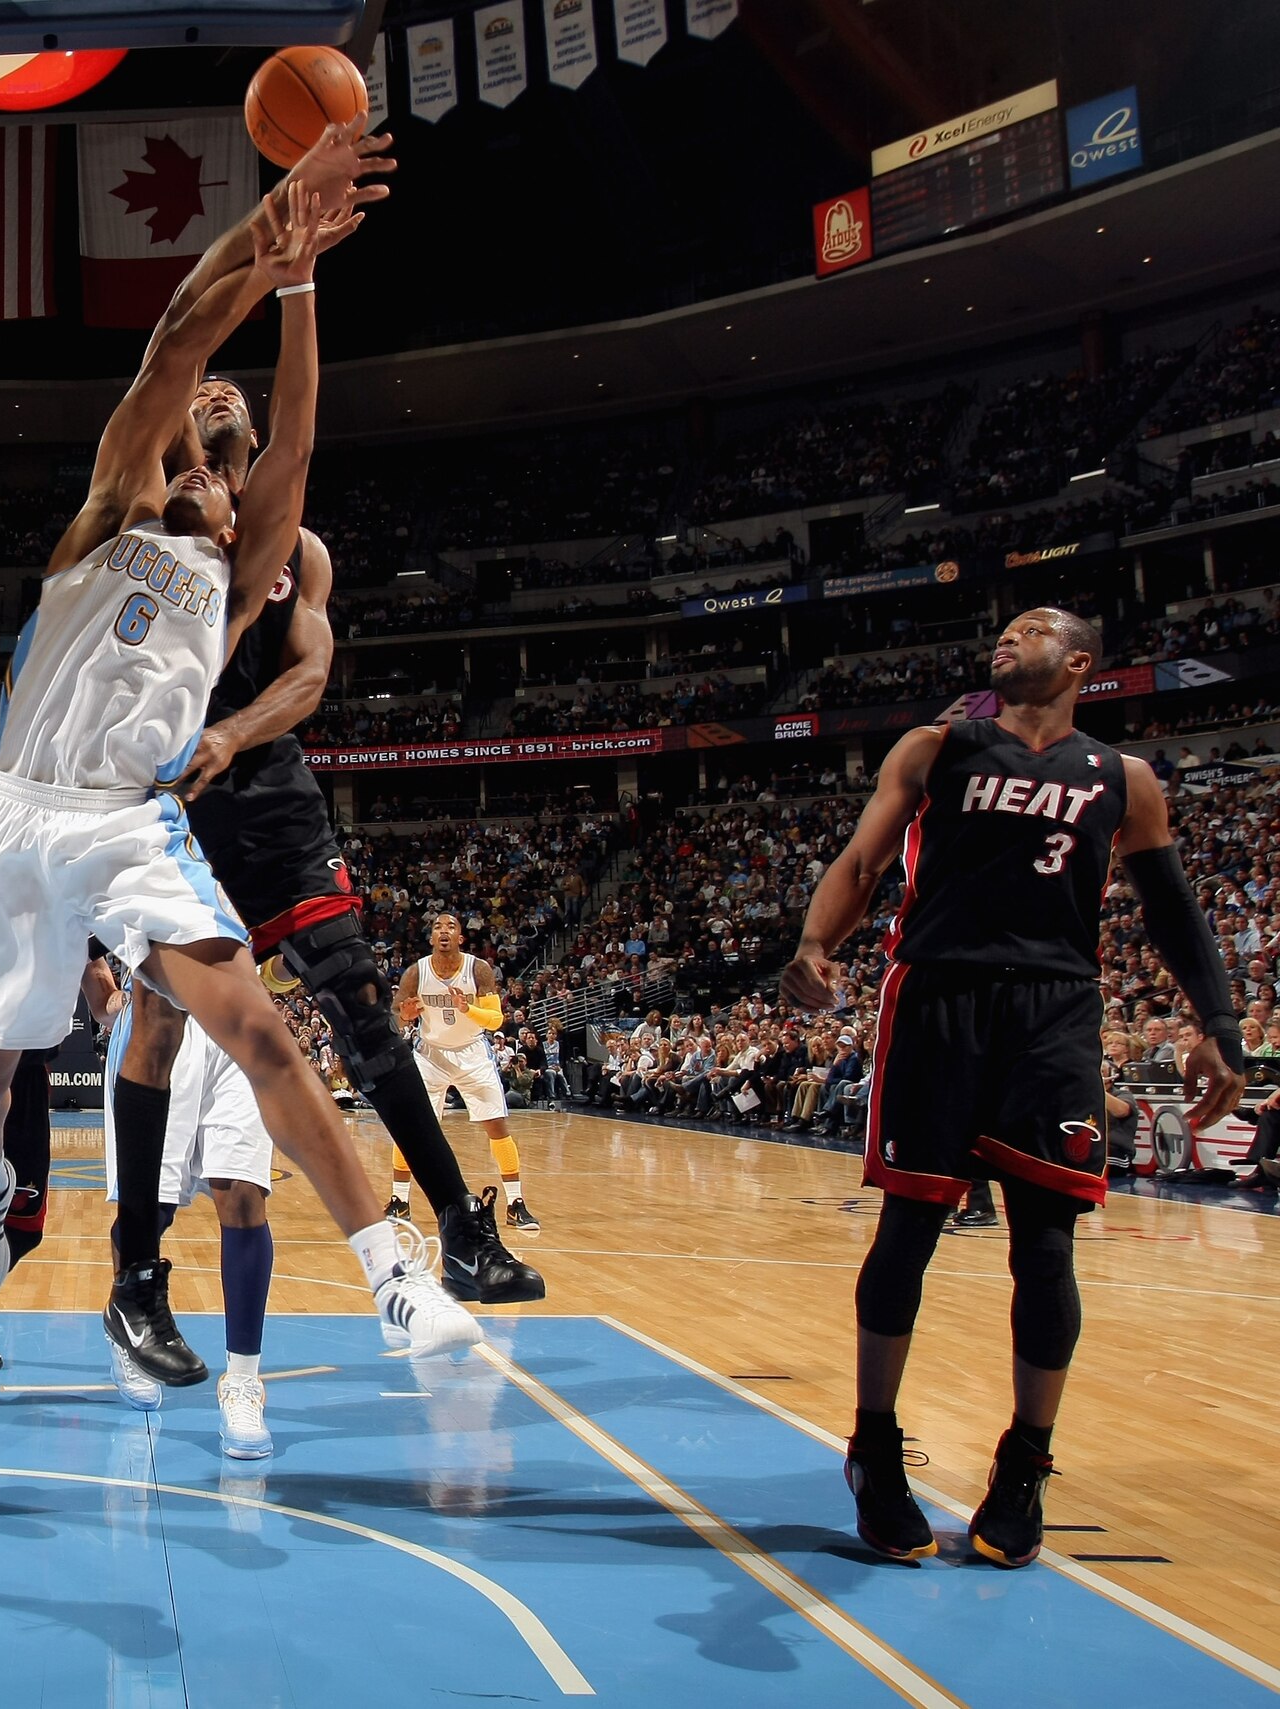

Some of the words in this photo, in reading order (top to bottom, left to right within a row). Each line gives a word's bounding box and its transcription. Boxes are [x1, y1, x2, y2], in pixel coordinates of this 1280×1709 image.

[1071, 136, 1137, 169] Qwest
[824, 227, 859, 251] Arby's
[1040, 543, 1080, 560] LIGHT
[104, 534, 222, 627] UGGETS
[704, 596, 756, 613] Qwest
[114, 592, 160, 646] 6
[774, 720, 812, 731] ACME
[774, 729, 812, 740] BRICK
[302, 755, 332, 765] FOR
[339, 752, 398, 764] DENVER
[405, 748, 460, 761] HOMES
[464, 745, 511, 757] SINCE
[517, 743, 554, 754] 1891
[572, 737, 651, 751] brick.com
[1184, 768, 1223, 782] SWISH'S
[962, 775, 1104, 824] HEAT
[1033, 832, 1074, 874] 3
[442, 1009, 456, 1025] 5
[48, 1072, 102, 1087] NBA.COM
